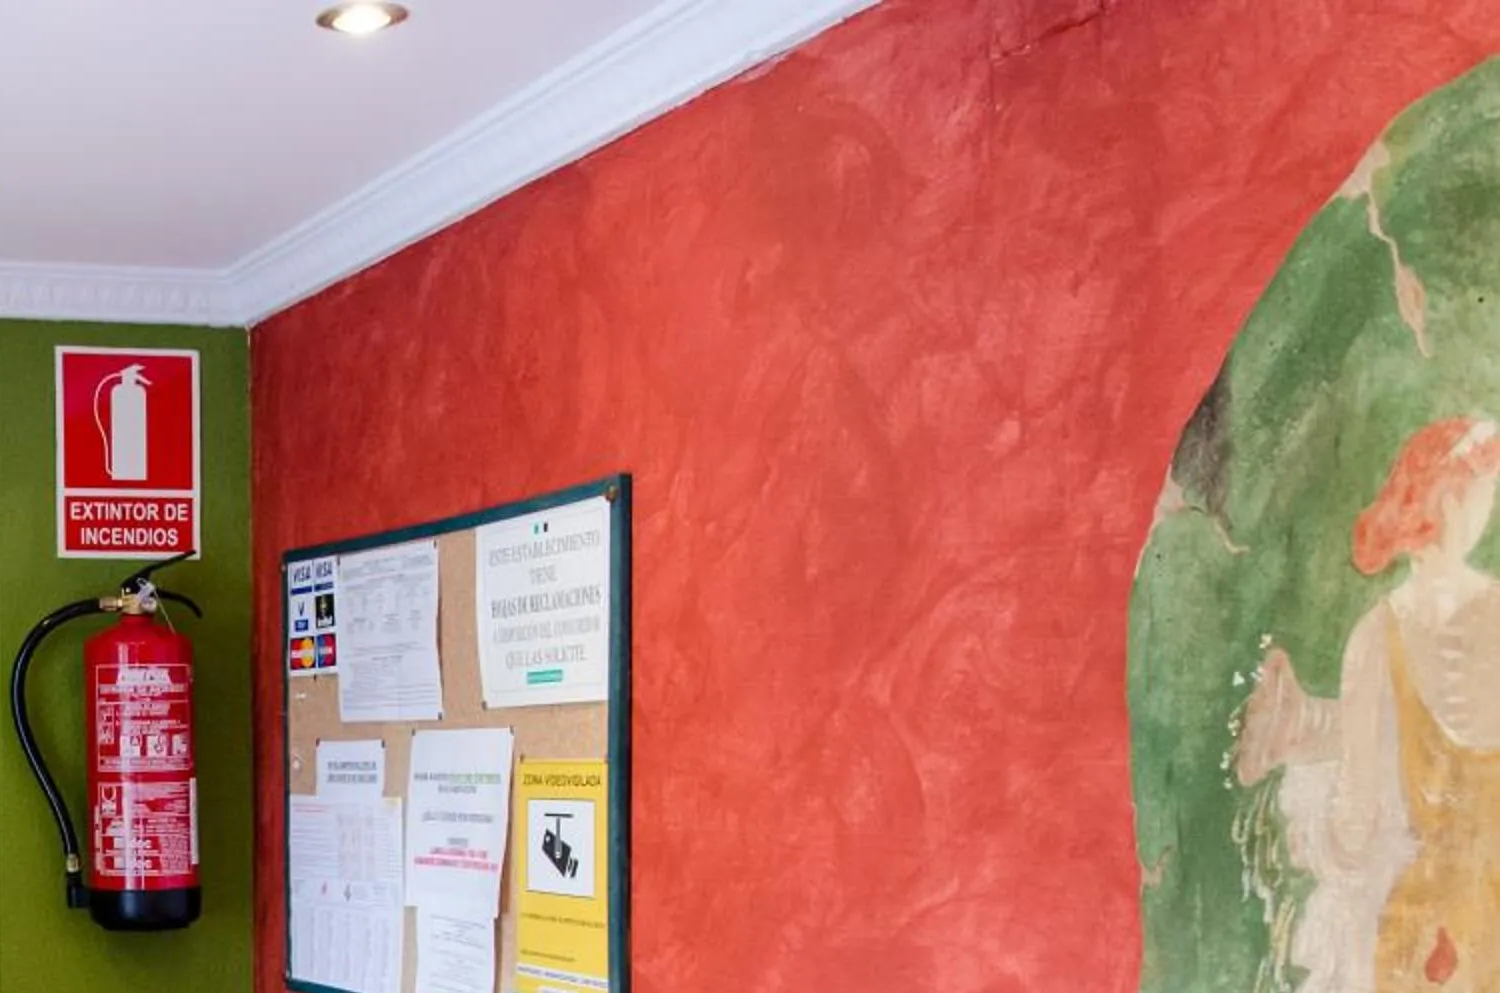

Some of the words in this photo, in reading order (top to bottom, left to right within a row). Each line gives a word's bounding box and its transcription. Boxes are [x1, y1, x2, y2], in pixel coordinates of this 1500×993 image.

[70, 502, 159, 521] EXTINTOR
[164, 504, 189, 522] DE
[80, 527, 178, 546] INCENDIOS
[293, 565, 311, 582] VISA
[316, 561, 332, 578] VISA
[523, 773, 542, 785] ZONA
